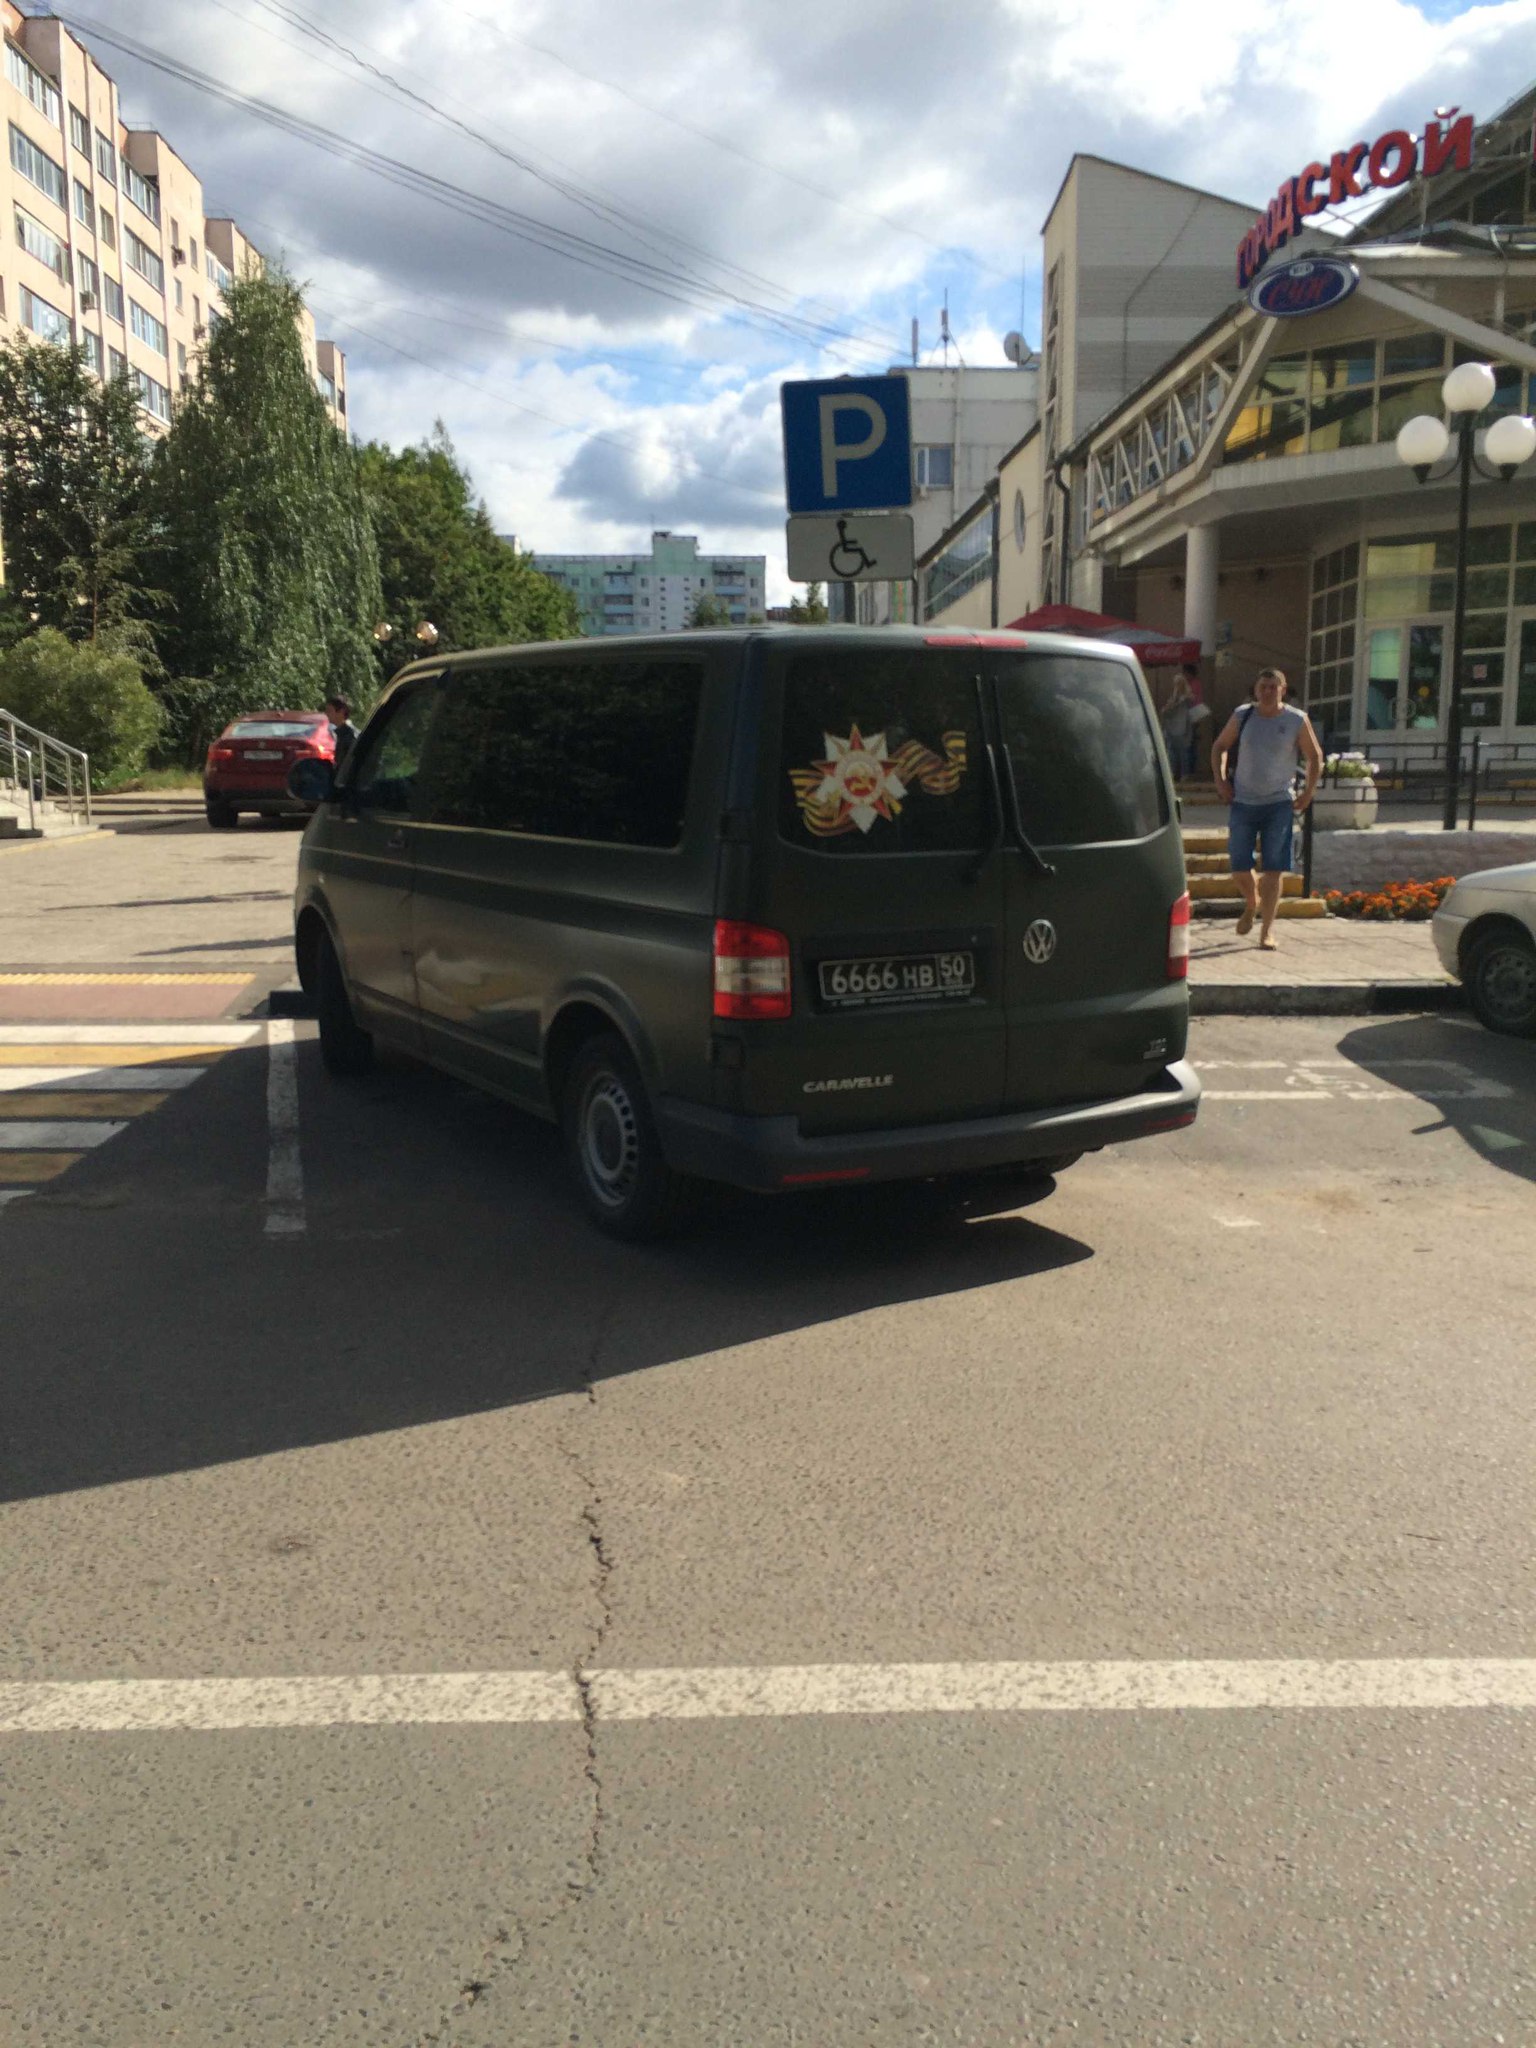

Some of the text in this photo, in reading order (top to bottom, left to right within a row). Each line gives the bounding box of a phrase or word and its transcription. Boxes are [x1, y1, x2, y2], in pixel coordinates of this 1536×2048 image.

[1236, 107, 1475, 290] ГОРОДСКОЙ
[818, 392, 888, 498] P
[831, 961, 898, 994] 6666
[940, 954, 966, 977] 50
[802, 1074, 894, 1093] CARAVELLE
